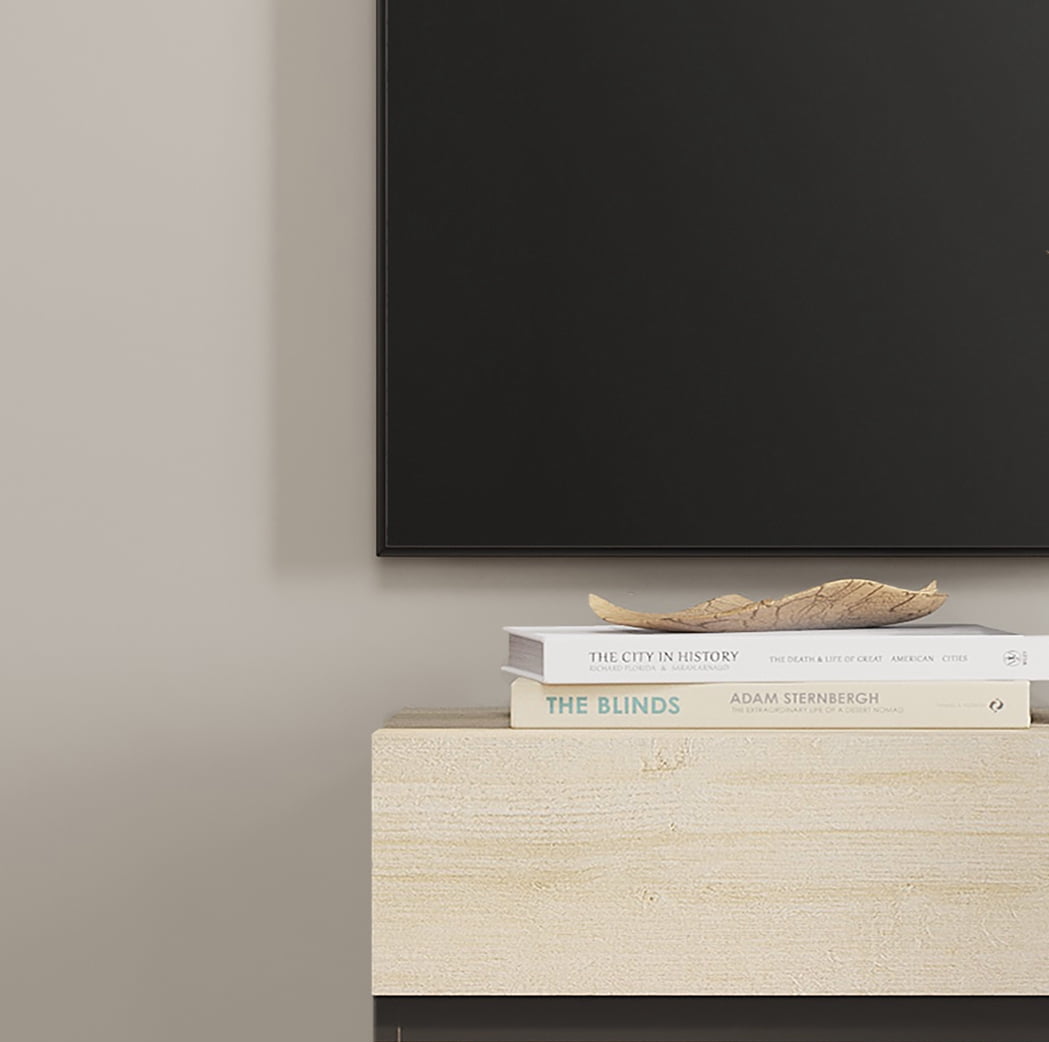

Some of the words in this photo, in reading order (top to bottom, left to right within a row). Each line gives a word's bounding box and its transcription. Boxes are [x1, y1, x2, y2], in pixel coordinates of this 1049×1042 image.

[588, 651, 618, 663] THE
[622, 651, 655, 663] CITY
[658, 651, 675, 663] IN
[678, 650, 740, 663] HISTORY
[769, 655, 786, 664] THE
[787, 655, 815, 664] DEATH
[816, 655, 824, 664] &
[825, 655, 843, 664] LIFE
[844, 655, 856, 664] OF
[857, 655, 883, 664] GREAT
[891, 654, 935, 663] AMERICAN
[942, 654, 969, 663] CITIES
[729, 692, 779, 704] ADAM
[783, 692, 880, 704] STERNBERGH
[546, 696, 588, 715] THE
[598, 696, 681, 715] BLINDS
